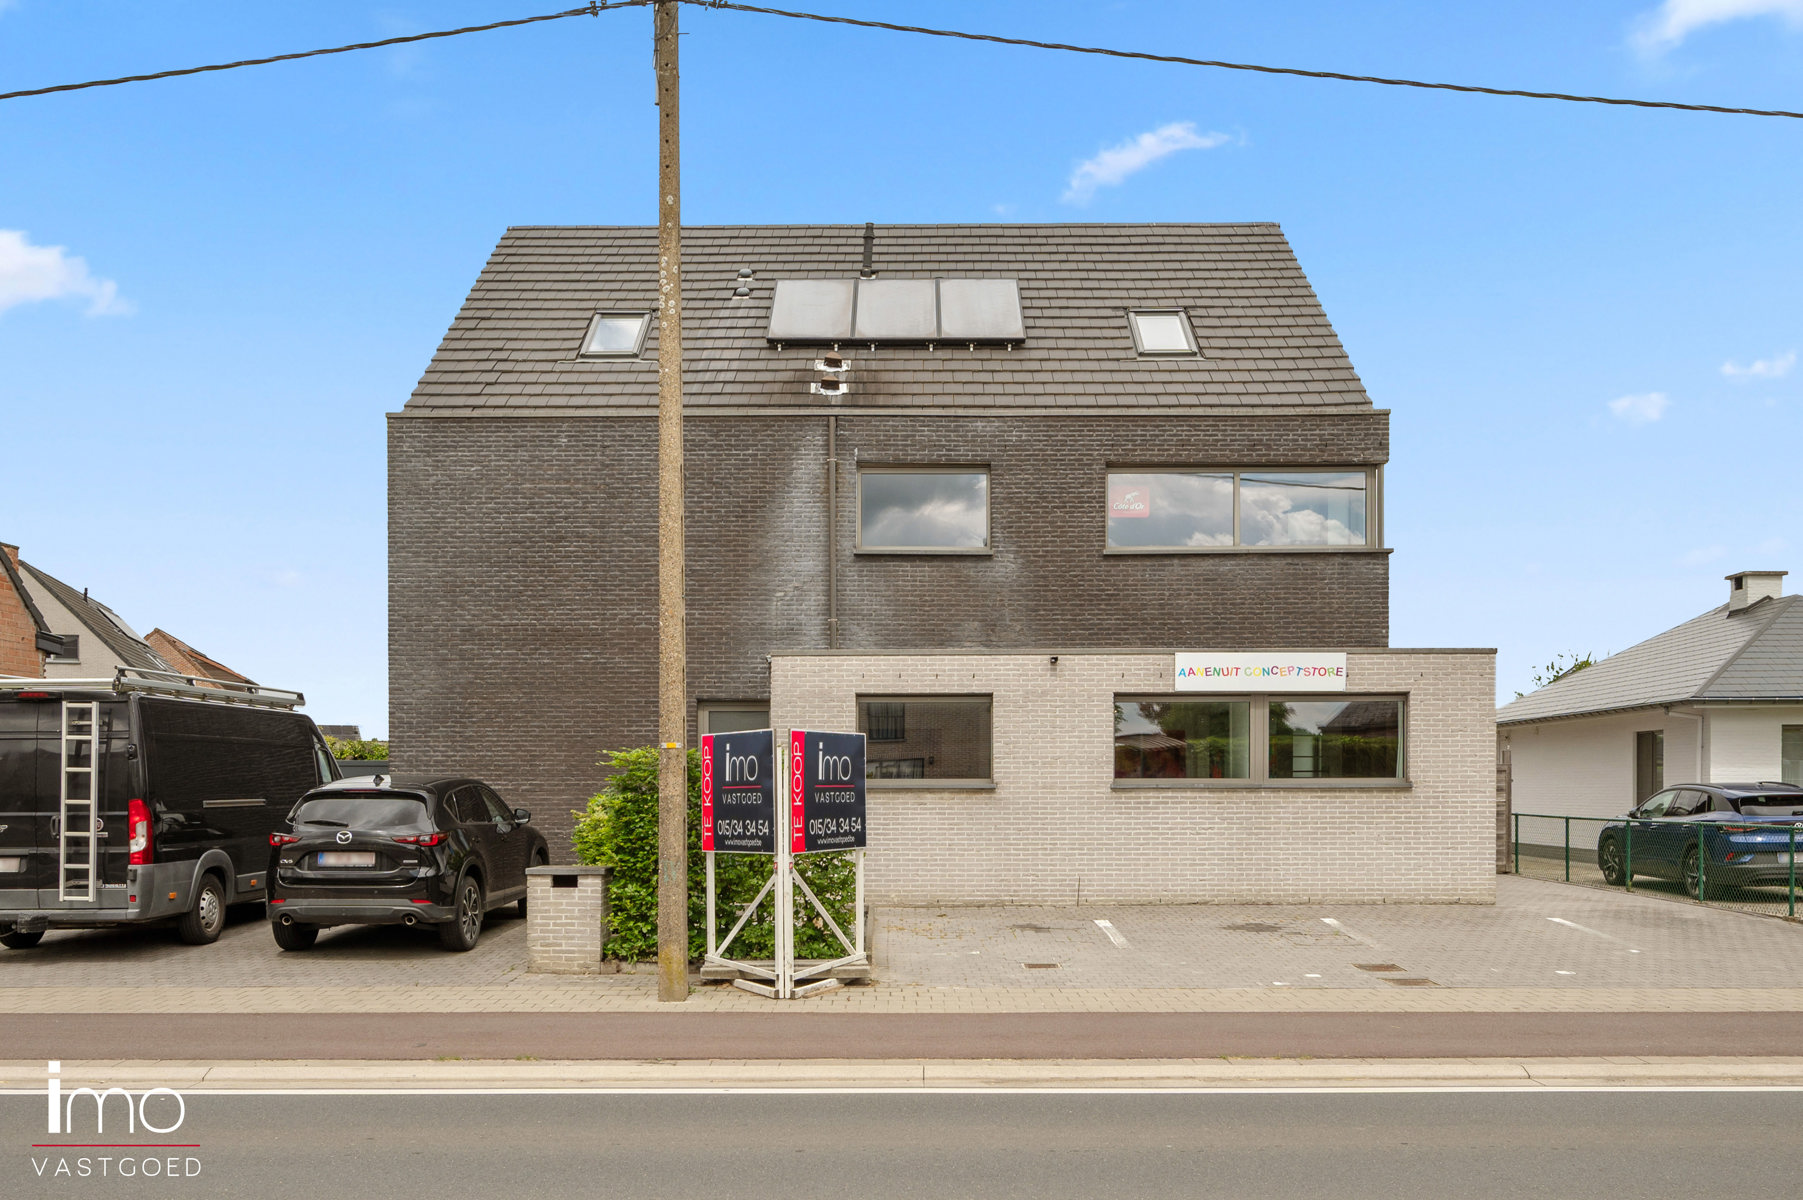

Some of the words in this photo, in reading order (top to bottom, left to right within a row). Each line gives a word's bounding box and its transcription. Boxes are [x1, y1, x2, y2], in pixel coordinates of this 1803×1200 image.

[1178, 667, 1241, 678] AANENUIT
[1244, 665, 1343, 677] CONCEPTSTORE
[725, 743, 758, 782] imo
[818, 741, 851, 781] imo
[703, 745, 712, 807] KOOP
[793, 741, 803, 806] KOOP
[722, 792, 763, 805] VASTGOED
[814, 791, 856, 804] VASTGOED
[703, 816, 712, 840] TE
[717, 819, 743, 838] 015/34
[745, 819, 756, 836] 34
[758, 820, 769, 836] 54
[793, 816, 803, 842] TE
[809, 818, 837, 837] 015/34
[838, 817, 849, 833] 34
[850, 816, 861, 833] 54
